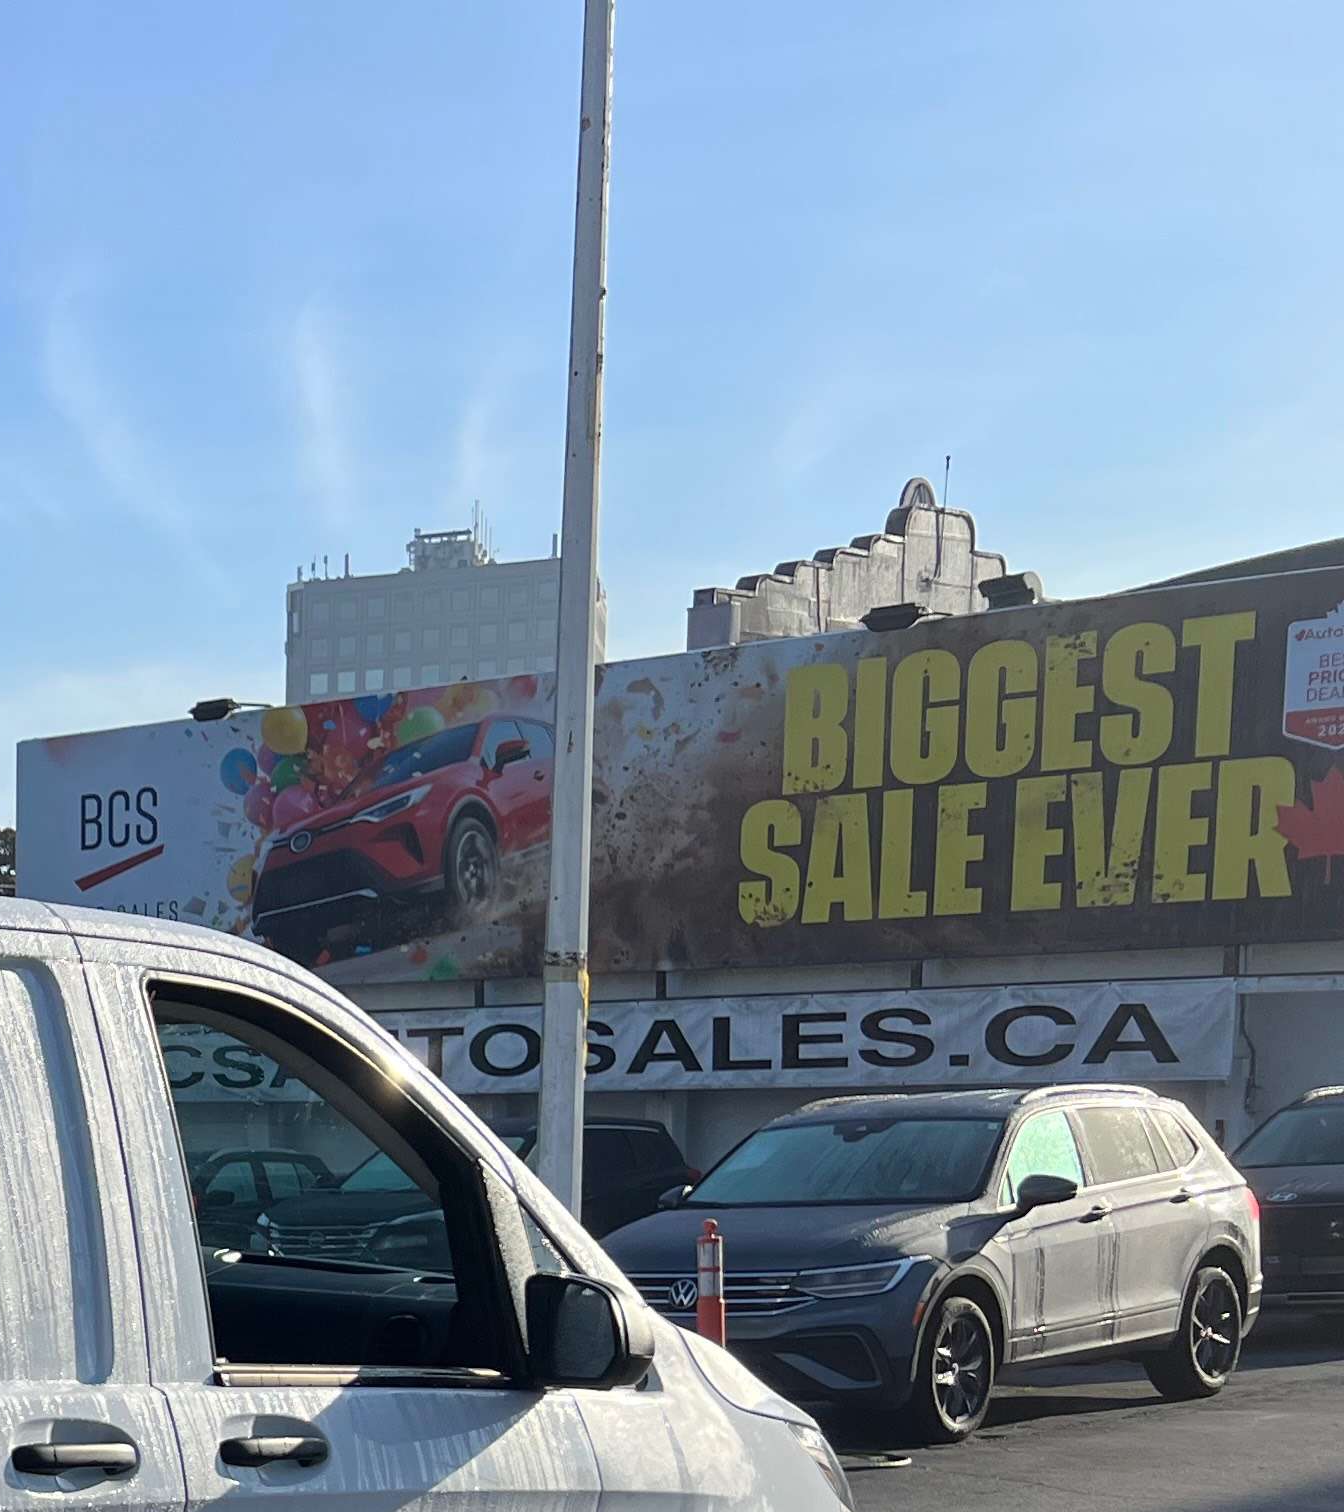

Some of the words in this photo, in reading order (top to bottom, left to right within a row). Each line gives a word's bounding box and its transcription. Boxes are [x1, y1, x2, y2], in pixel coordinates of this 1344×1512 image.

[1304, 625, 1344, 640] Auto
[1319, 652, 1344, 668] BE
[782, 611, 1256, 795] BIGGEST
[81, 787, 158, 850] BCS
[738, 780, 988, 928] SALE
[1012, 756, 1295, 912] EVER
